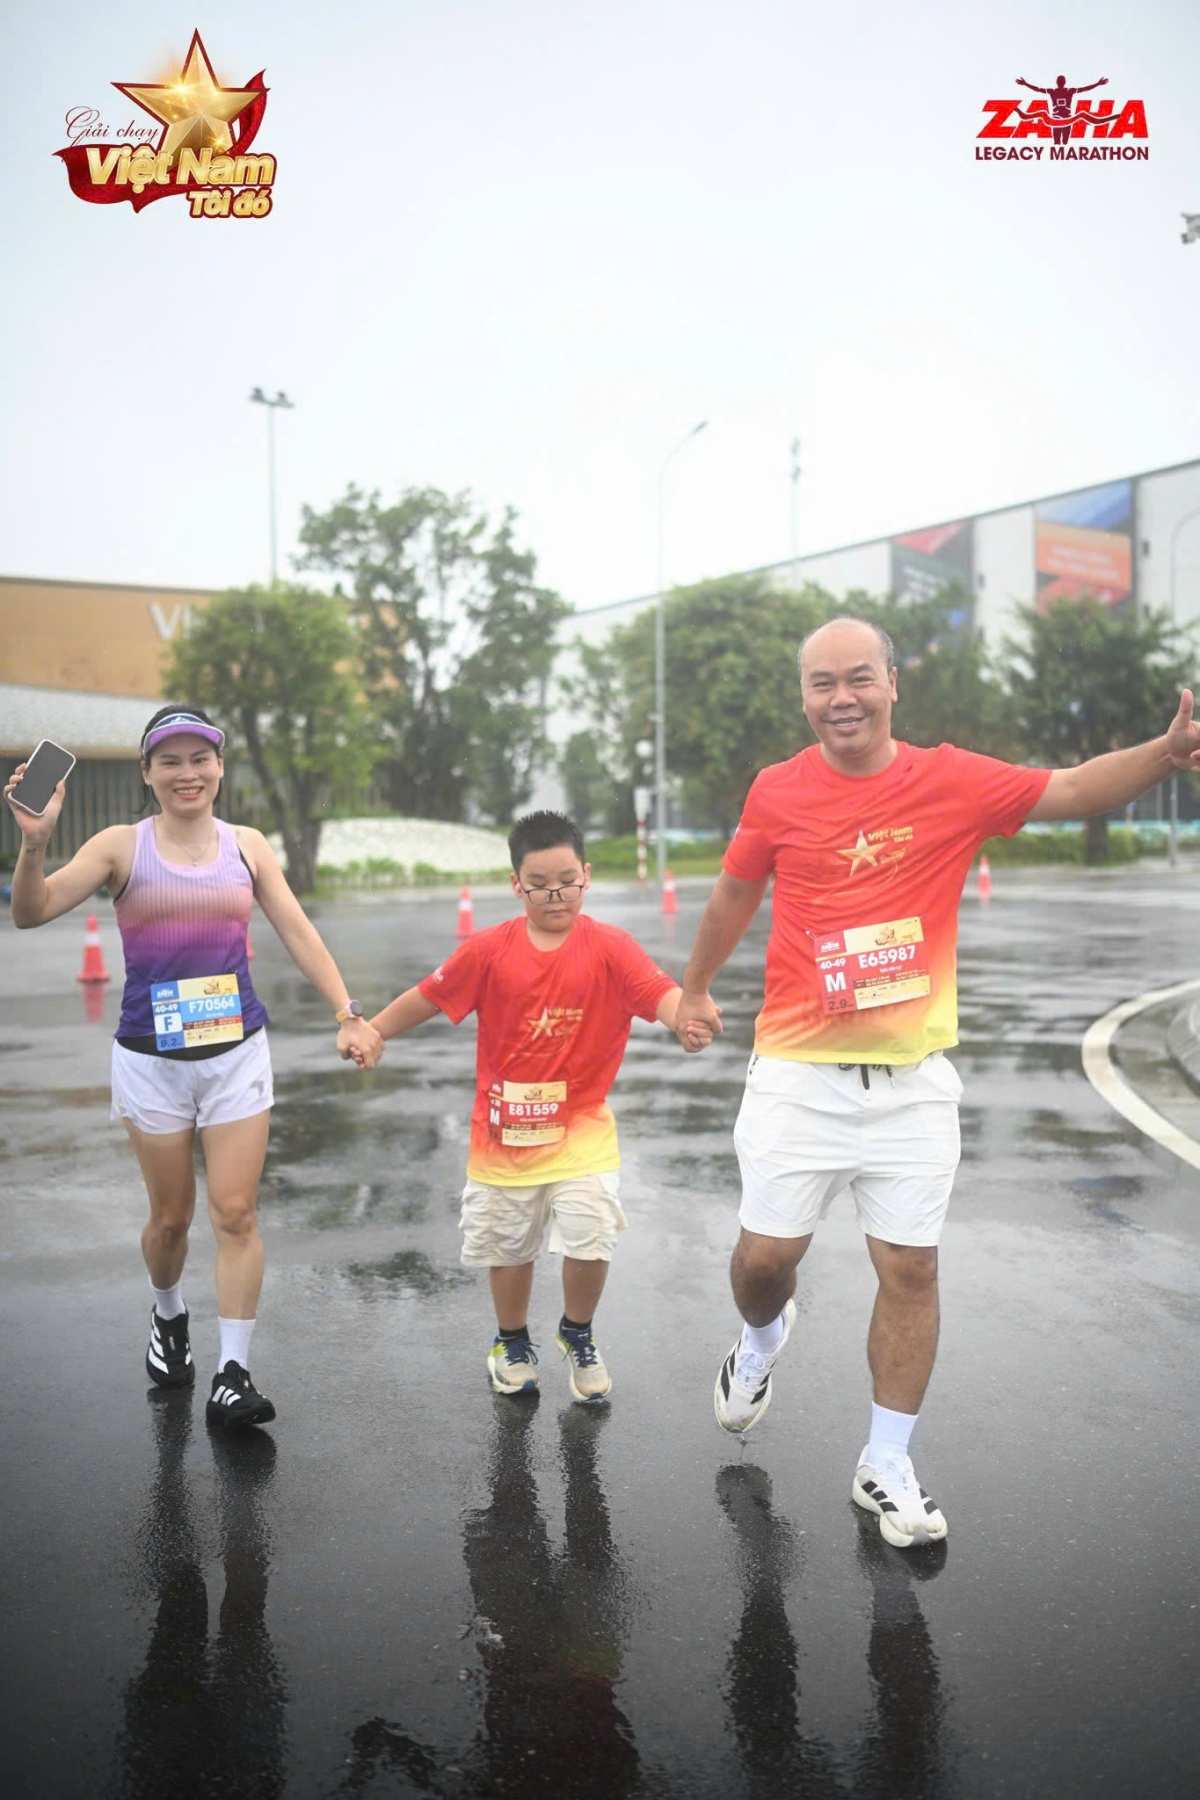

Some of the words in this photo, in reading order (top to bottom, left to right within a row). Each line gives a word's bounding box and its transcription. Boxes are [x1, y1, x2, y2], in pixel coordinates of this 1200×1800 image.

[820, 958, 847, 970] 40-49
[858, 945, 916, 969] E65987
[824, 971, 847, 993] M
[189, 996, 235, 1014] F70564
[164, 1016, 173, 1031] F
[508, 1103, 559, 1116] E81559
